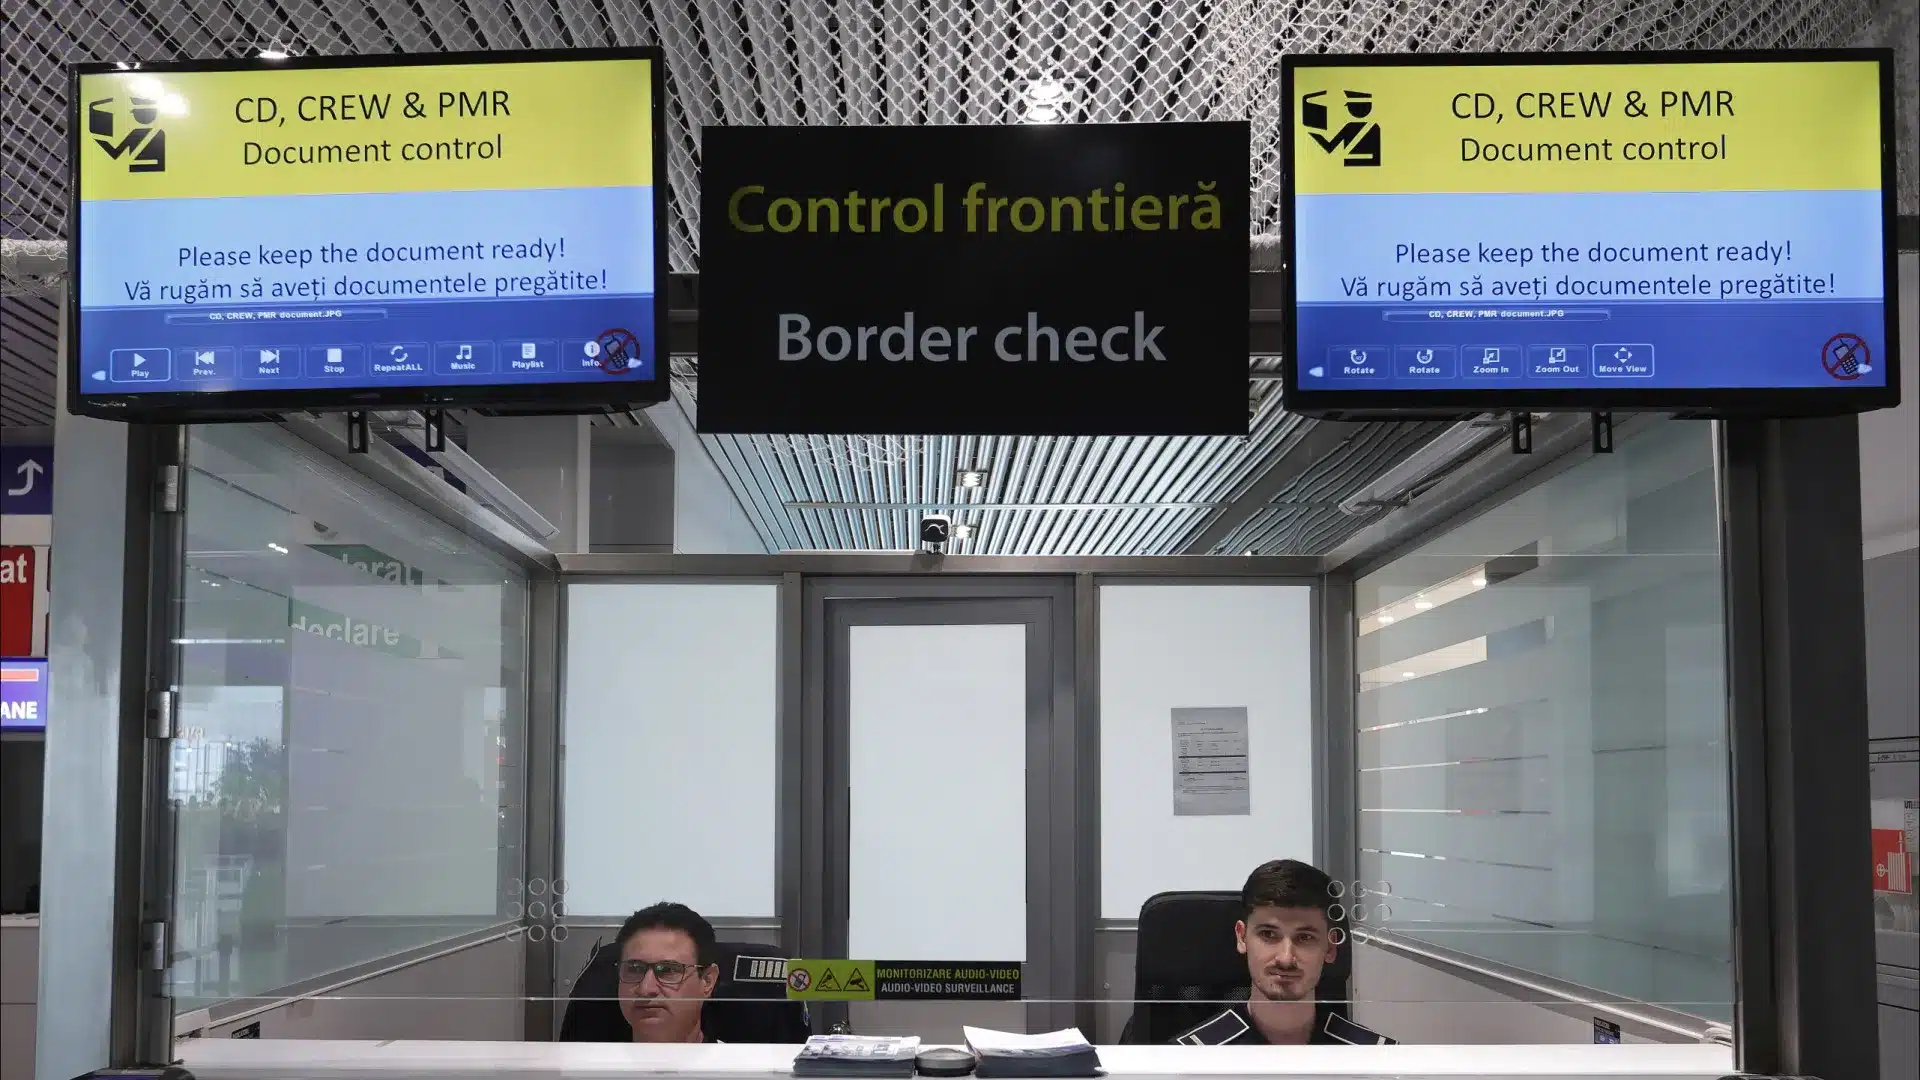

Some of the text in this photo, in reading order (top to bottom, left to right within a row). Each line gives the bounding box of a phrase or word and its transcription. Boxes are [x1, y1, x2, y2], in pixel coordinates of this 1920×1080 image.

[236, 91, 510, 127] CD, CREW & PMR
[1452, 91, 1734, 124] CD, CREW & PMR
[245, 134, 501, 165] Document control
[1462, 134, 1725, 161] Document control
[730, 181, 1220, 232] Control frontieră
[180, 238, 564, 268] Please keep the document ready!
[1397, 240, 1790, 267] Please keep the document ready!
[125, 270, 608, 303] Vă rugăm să aveți documentele pregătite!
[1341, 273, 1835, 301] Vă rugăm să aveți documentele pregătite!
[209, 312, 224, 321] CD,
[226, 312, 256, 320] CREW,
[280, 310, 342, 318] document.JPG
[1428, 311, 1444, 319] CD,
[1478, 310, 1498, 318] PMR
[1501, 310, 1564, 318] document.JPG
[779, 311, 1166, 361] Border check
[324, 365, 345, 373] Stop
[374, 363, 423, 372] RepeatALL
[450, 362, 476, 370] Music
[512, 360, 545, 369] Playlist
[1409, 366, 1440, 374] Rotate
[1472, 366, 1498, 374] Zoom
[1562, 365, 1579, 373] Out
[1599, 365, 1647, 373] Move View
[131, 369, 150, 379] Play
[193, 368, 216, 376] Prev.
[259, 367, 280, 375] Next
[877, 968, 1019, 980] MONITORIZARE AUDIO-VIDEO
[881, 982, 1015, 994] AUDIO-VIDEO SURVEILLANCE
